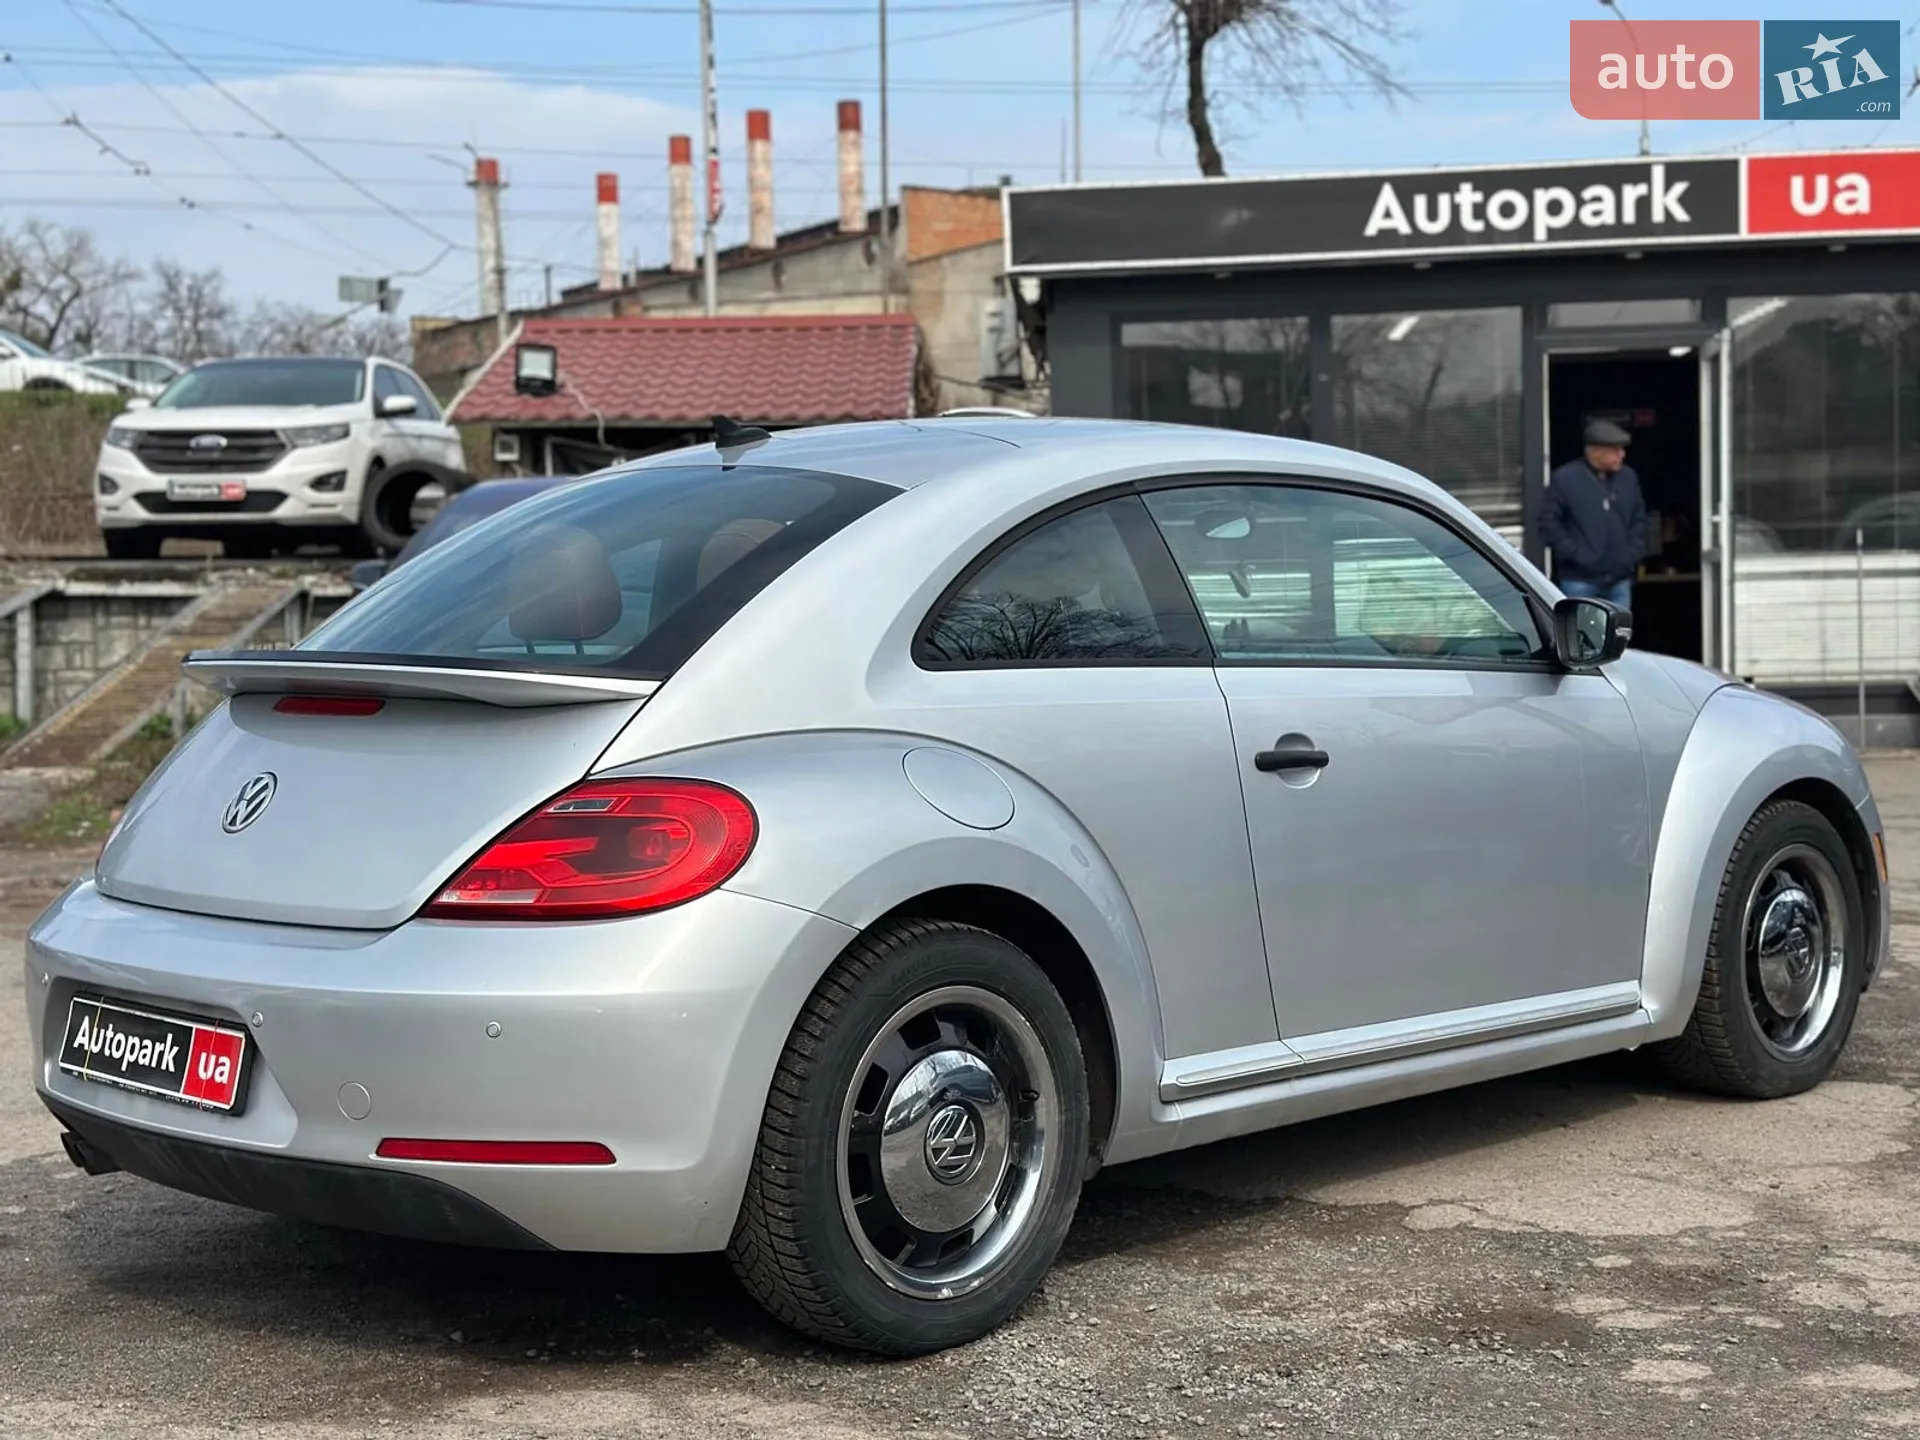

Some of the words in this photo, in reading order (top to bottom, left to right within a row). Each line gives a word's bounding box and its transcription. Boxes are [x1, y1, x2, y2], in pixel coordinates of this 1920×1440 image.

[1364, 163, 1692, 241] Autopark
[1790, 172, 1870, 217] ua
[73, 1015, 180, 1073] Autopark
[198, 1052, 231, 1085] ua
